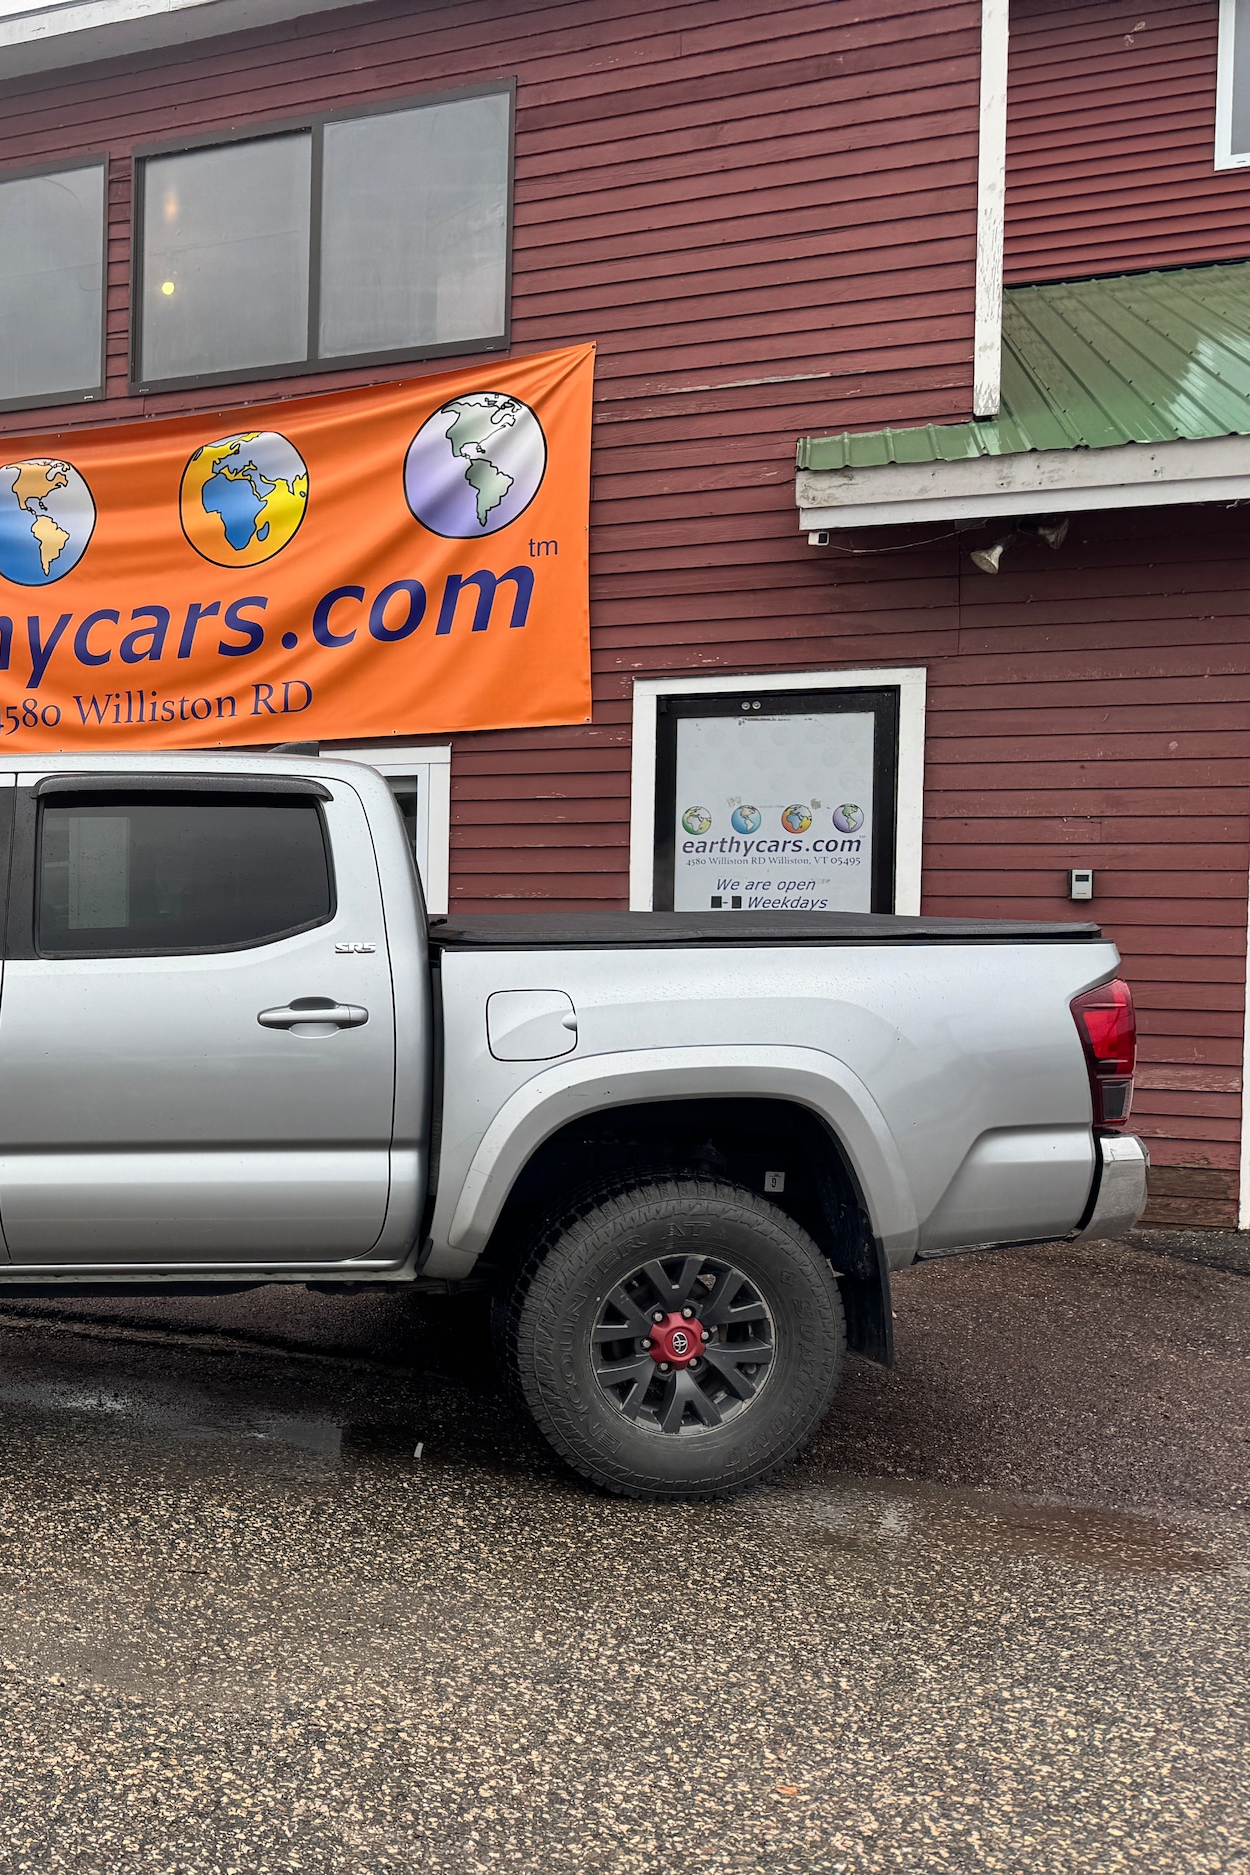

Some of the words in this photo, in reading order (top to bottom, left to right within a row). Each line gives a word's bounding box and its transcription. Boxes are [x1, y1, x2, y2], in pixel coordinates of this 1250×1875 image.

[528, 537, 559, 559] tm
[73, 690, 238, 727] Williston
[251, 680, 314, 715] RD
[682, 836, 862, 857] earthycars.com
[685, 858, 707, 867] 4580
[708, 857, 749, 865] Williston
[751, 857, 766, 865] RD
[768, 856, 811, 866] Williston,
[814, 856, 828, 865] VT
[830, 857, 861, 866] 05495
[716, 878, 740, 891] We
[745, 880, 772, 891] are
[777, 880, 816, 893] open
[748, 896, 829, 911] Weekdays
[334, 942, 376, 954] SR5
